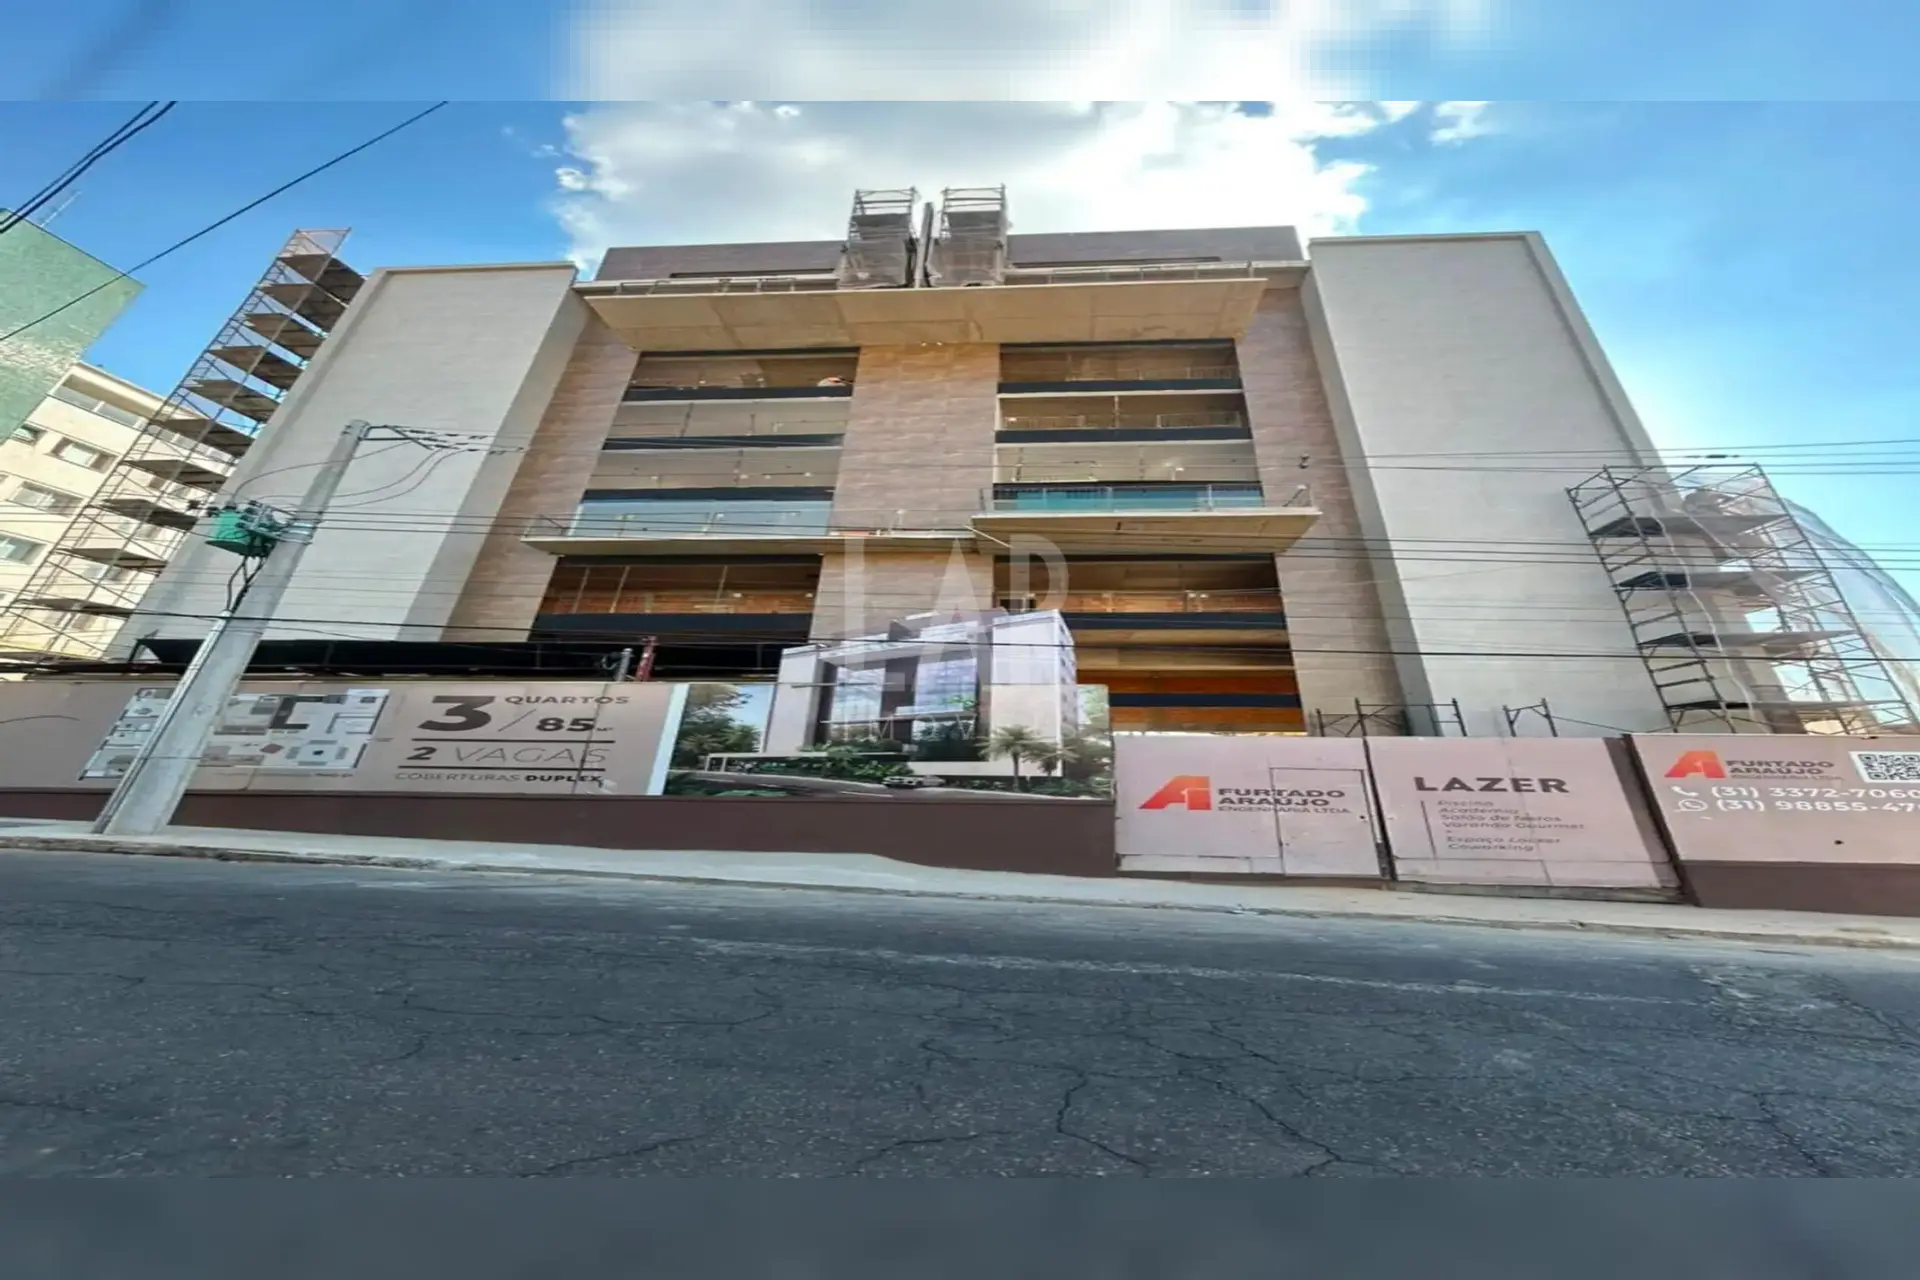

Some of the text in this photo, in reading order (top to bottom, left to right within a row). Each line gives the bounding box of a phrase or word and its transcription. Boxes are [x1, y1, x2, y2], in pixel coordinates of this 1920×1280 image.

[504, 695, 631, 705] QUARTOS
[417, 695, 497, 732] 3
[405, 746, 612, 764] 2 VAGAS
[1726, 760, 1835, 768] FURTADO
[395, 772, 602, 784] COBERTURAS DUPLEX
[1413, 776, 1570, 794] LAZER
[1218, 788, 1346, 798] FURTADO
[1711, 785, 1920, 799] (31) 3372-7060
[1716, 798, 1920, 812] (31) 98855-47
[1438, 807, 1520, 815] Academia
[1442, 821, 1585, 830] Varanda Gourmet
[1446, 835, 1504, 844] Espaço
[1448, 843, 1535, 852] Coworking
